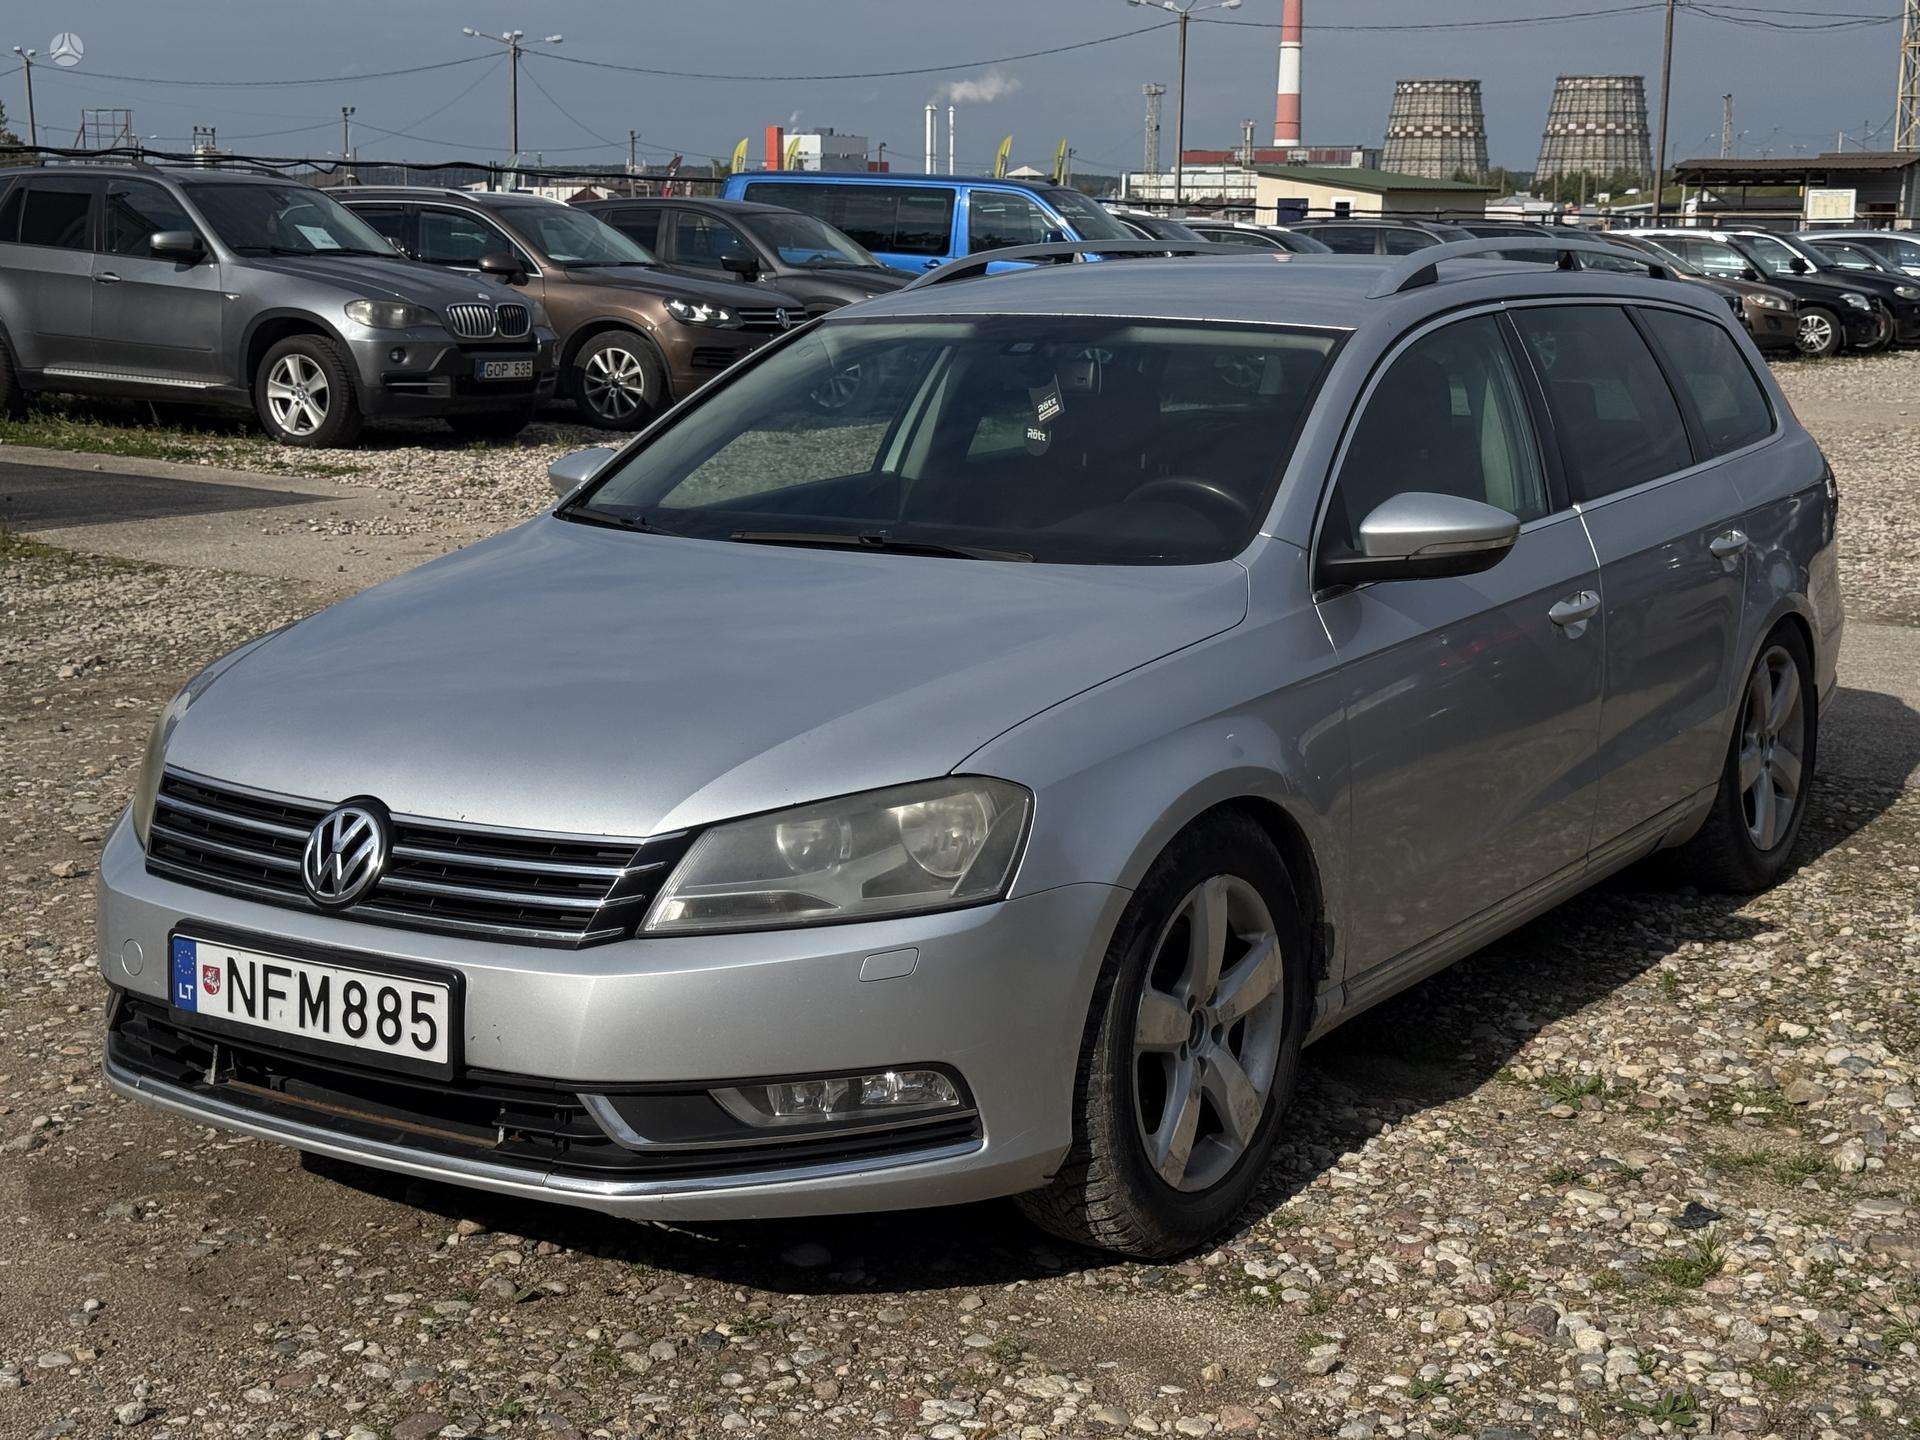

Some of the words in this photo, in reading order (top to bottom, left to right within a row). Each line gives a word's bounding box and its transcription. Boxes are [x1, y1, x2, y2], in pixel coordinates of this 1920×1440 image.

[487, 363, 509, 376] GOP
[514, 362, 531, 376] 535
[178, 983, 194, 1001] LT
